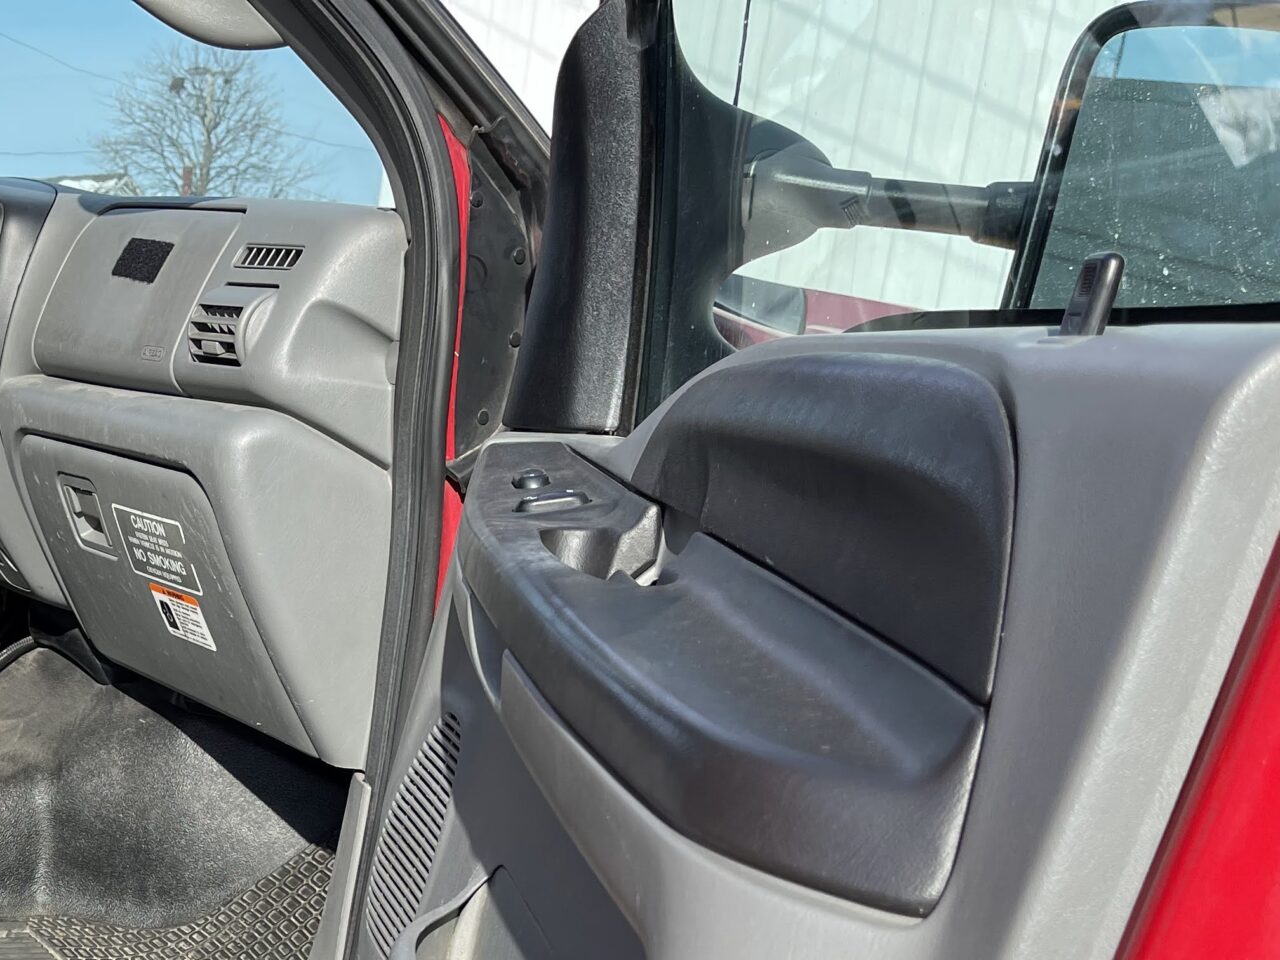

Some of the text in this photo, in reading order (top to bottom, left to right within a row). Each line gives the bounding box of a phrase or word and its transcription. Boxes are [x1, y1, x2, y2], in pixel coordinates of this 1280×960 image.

[131, 515, 166, 537] CAUTION
[133, 547, 187, 575] NO SMOKING
